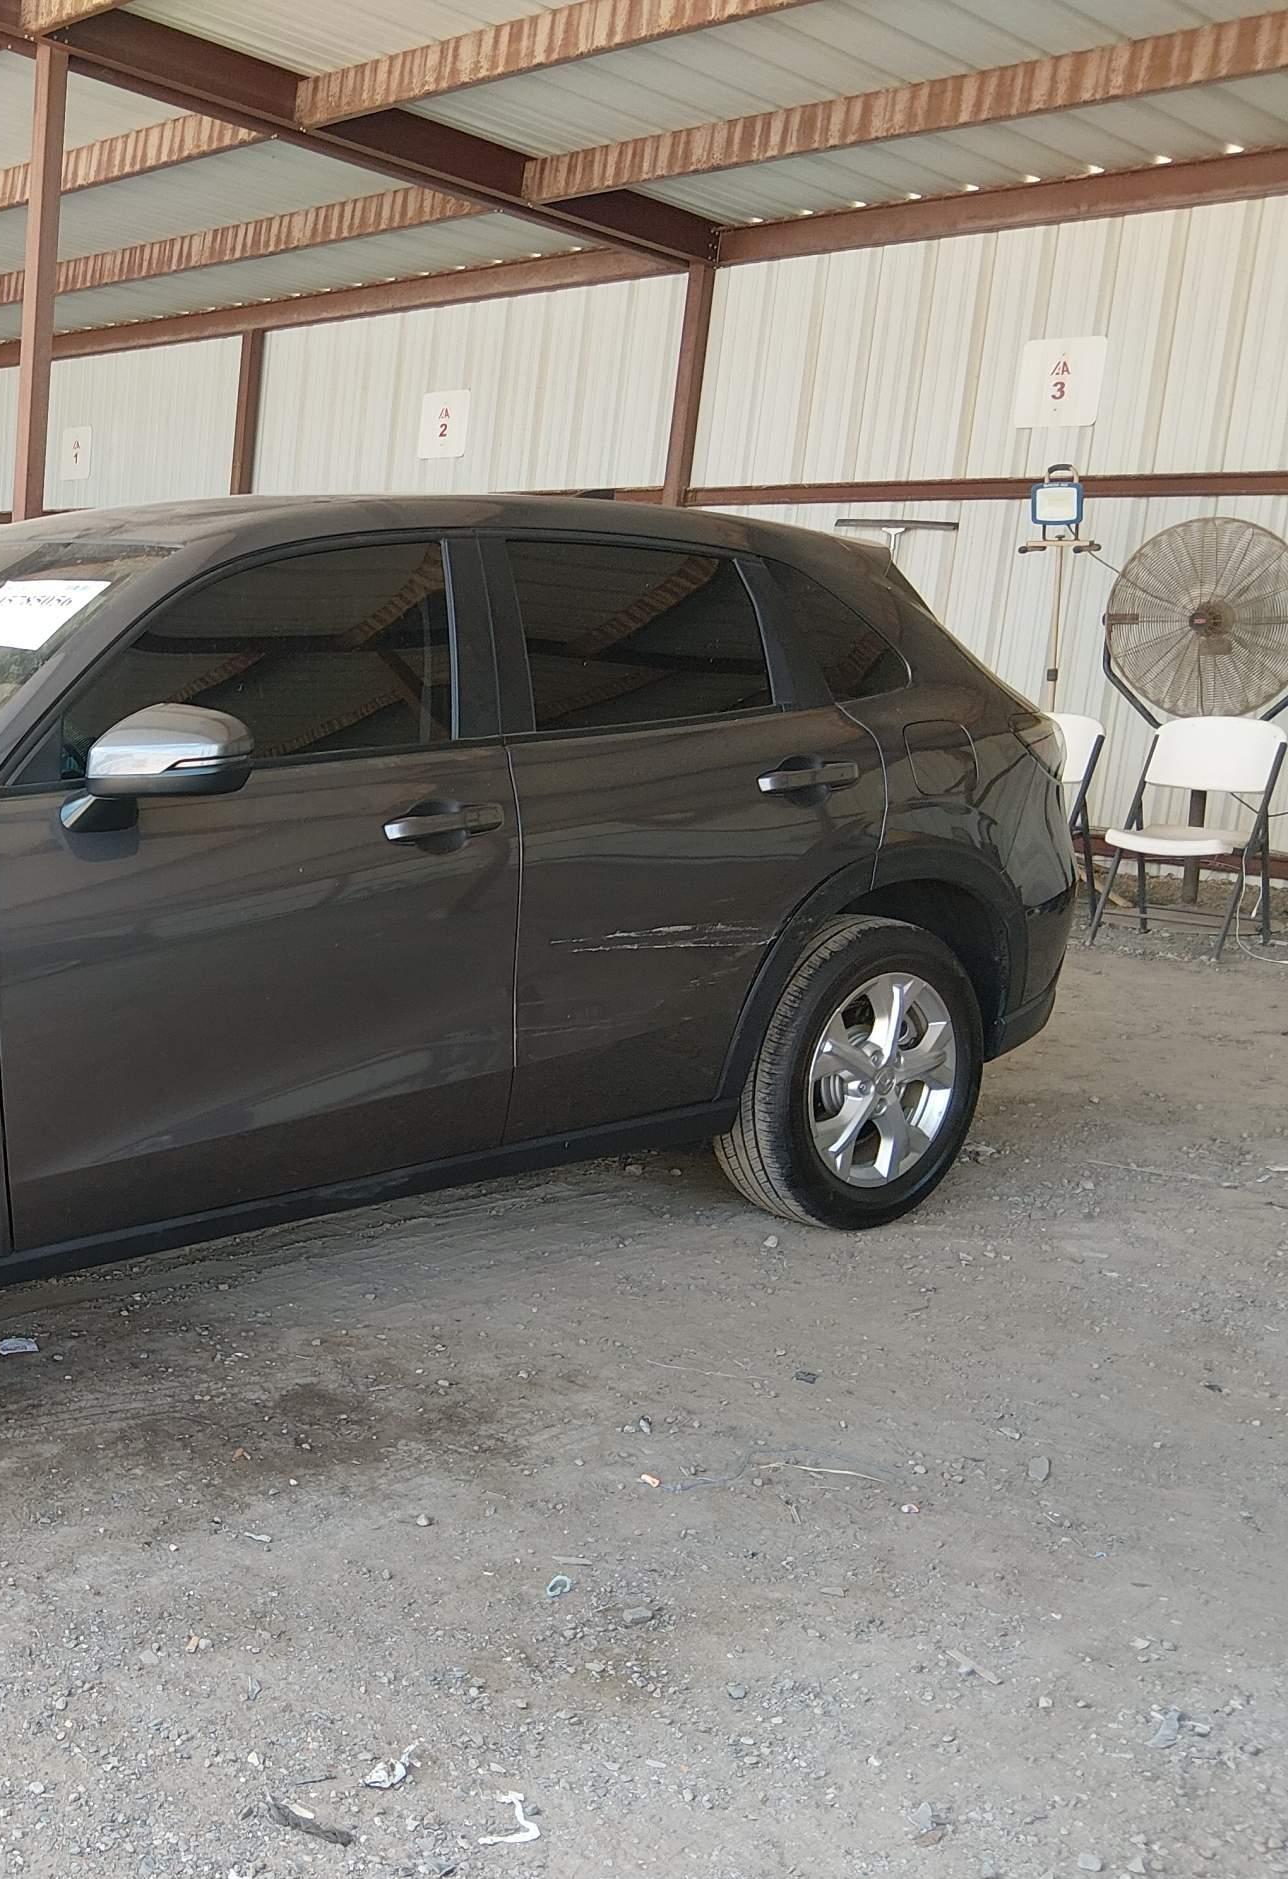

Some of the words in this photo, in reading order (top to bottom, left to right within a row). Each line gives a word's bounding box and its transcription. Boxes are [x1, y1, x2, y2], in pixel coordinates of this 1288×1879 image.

[1051, 381, 1066, 400] 3
[439, 423, 448, 438] 2
[73, 452, 79, 465] 1
